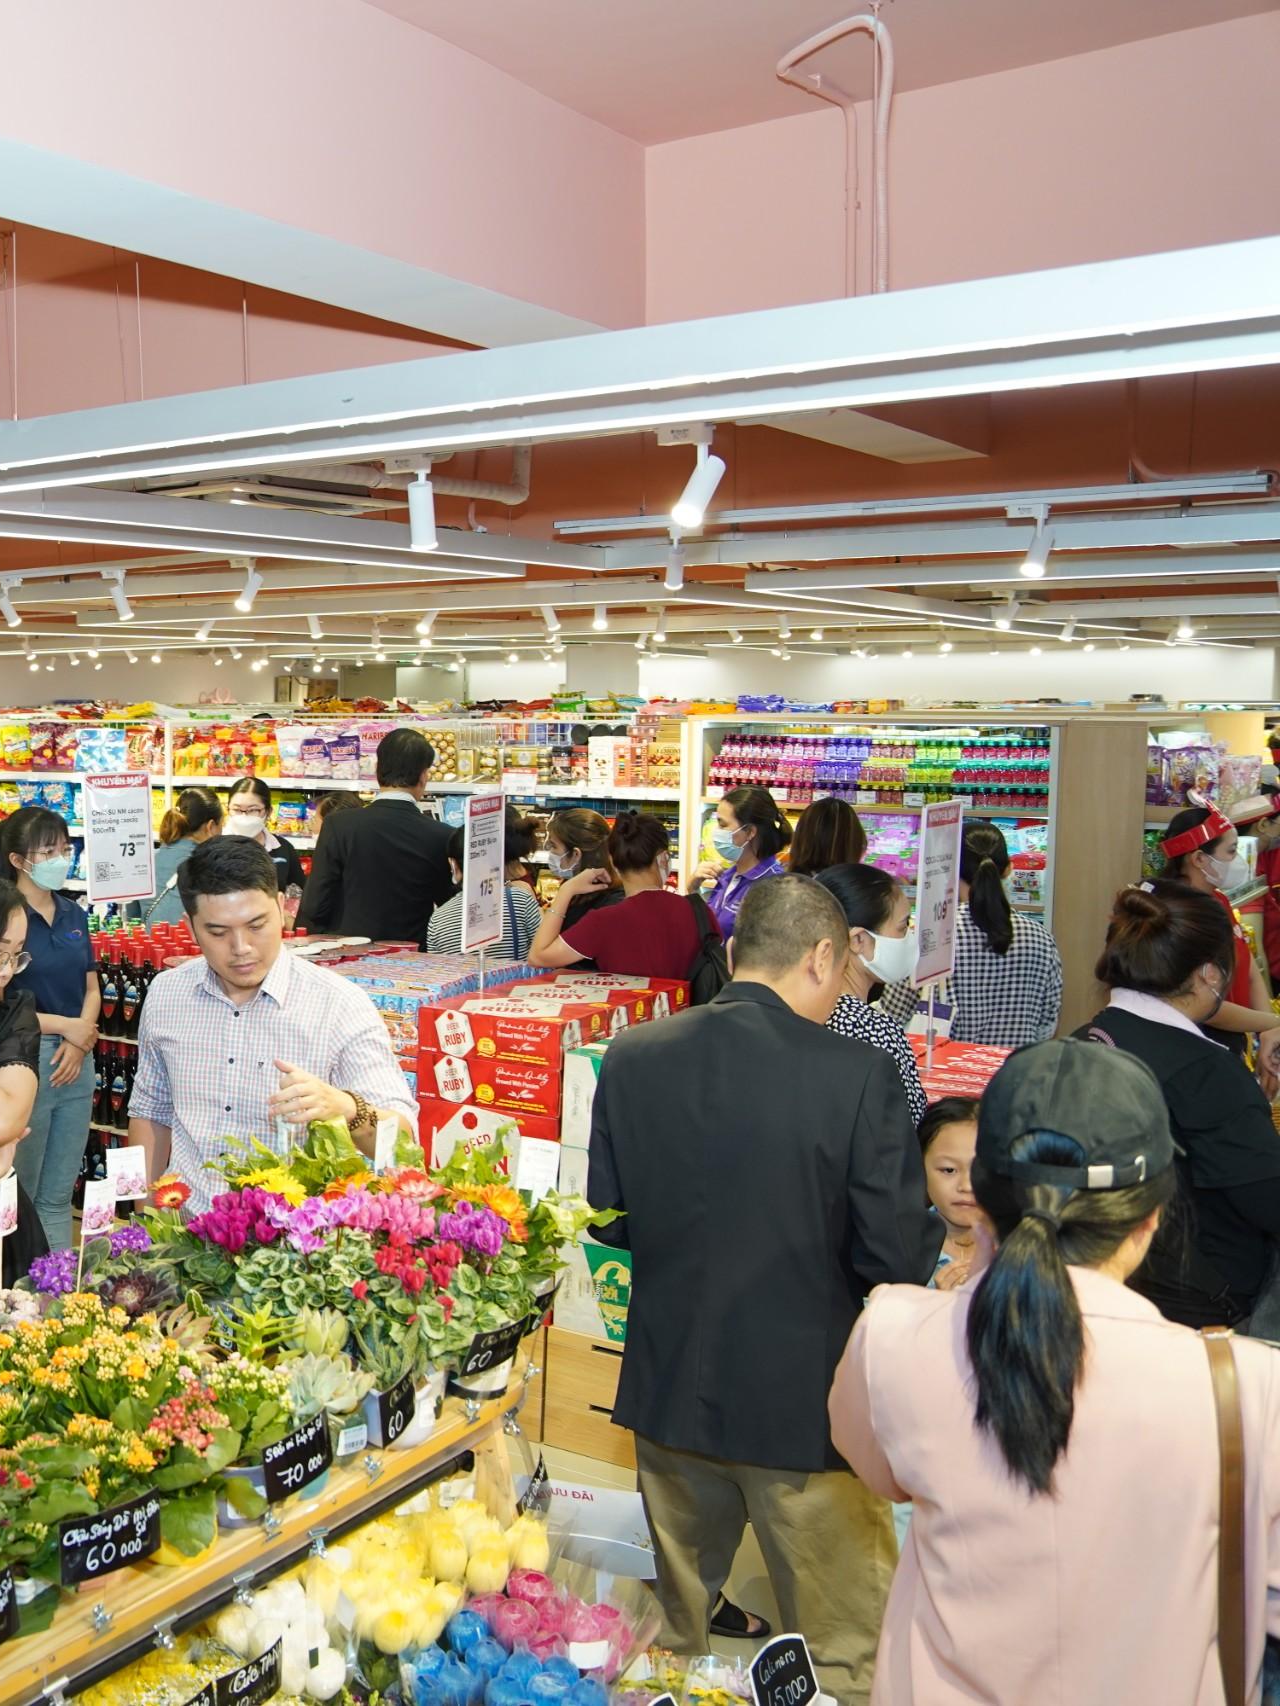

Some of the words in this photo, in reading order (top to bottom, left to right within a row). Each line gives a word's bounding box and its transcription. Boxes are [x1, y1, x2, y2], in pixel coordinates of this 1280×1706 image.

[120, 842, 136, 857] 73
[480, 878, 494, 897] 175
[529, 992, 587, 1000] RUBY
[444, 1032, 467, 1047] RUBY
[443, 1077, 466, 1092] RUBY
[466, 1350, 493, 1373] 60
[388, 1410, 404, 1440] 60
[276, 1463, 305, 1488] 70
[308, 1453, 322, 1472] 000
[86, 1542, 116, 1572] 60
[120, 1537, 142, 1558] 000
[758, 1649, 796, 1685] Calimero
